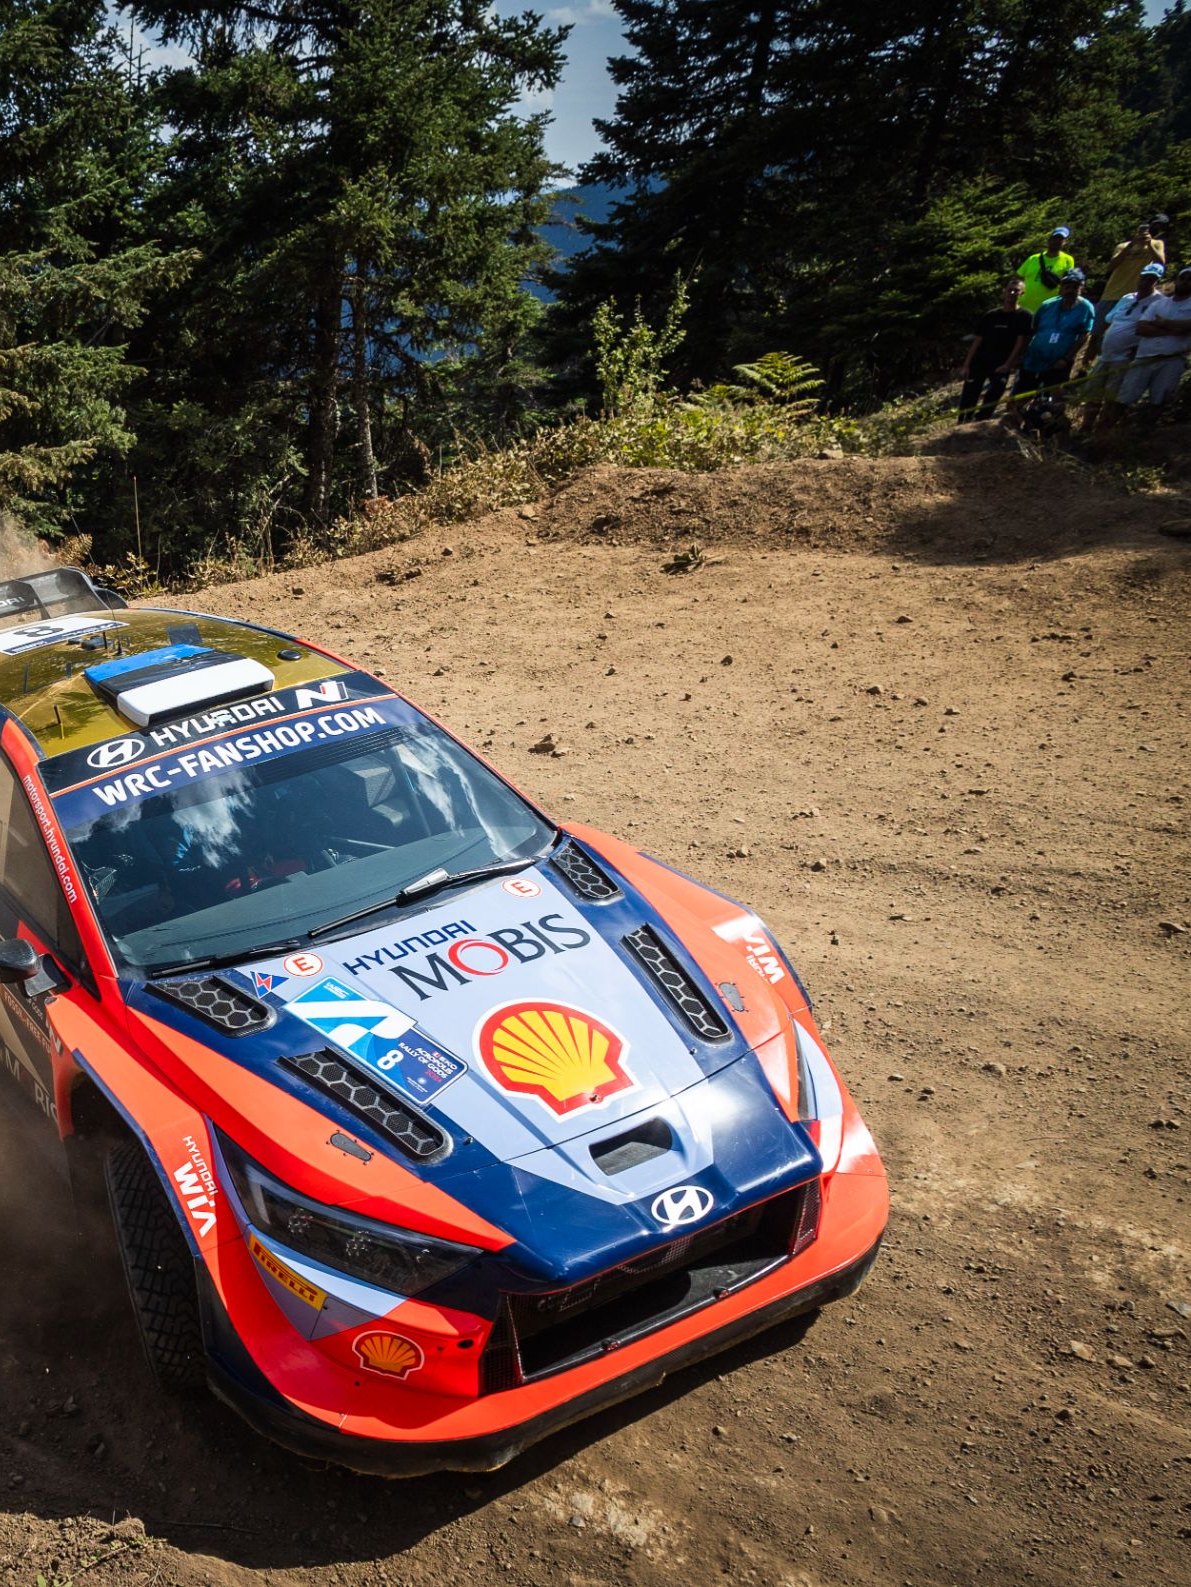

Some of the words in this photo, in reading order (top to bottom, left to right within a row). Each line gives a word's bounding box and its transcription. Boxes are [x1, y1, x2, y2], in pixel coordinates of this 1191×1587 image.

[92, 707, 387, 806] WRC-FANSHOP.COM
[23, 774, 78, 904] motorsport.hyundai.com
[512, 880, 533, 894] E
[291, 956, 316, 972] E
[341, 919, 479, 976] HYUNDAI
[387, 912, 592, 1002] MOBIS
[376, 1049, 404, 1071] 8
[398, 1042, 420, 1058] RALLY
[427, 1063, 449, 1079] GODS
[415, 1047, 454, 1075] ACROPOLIS
[182, 1135, 219, 1196] HYUNDAI
[173, 1162, 217, 1238] WIA
[253, 1242, 319, 1303] PIRELLI
